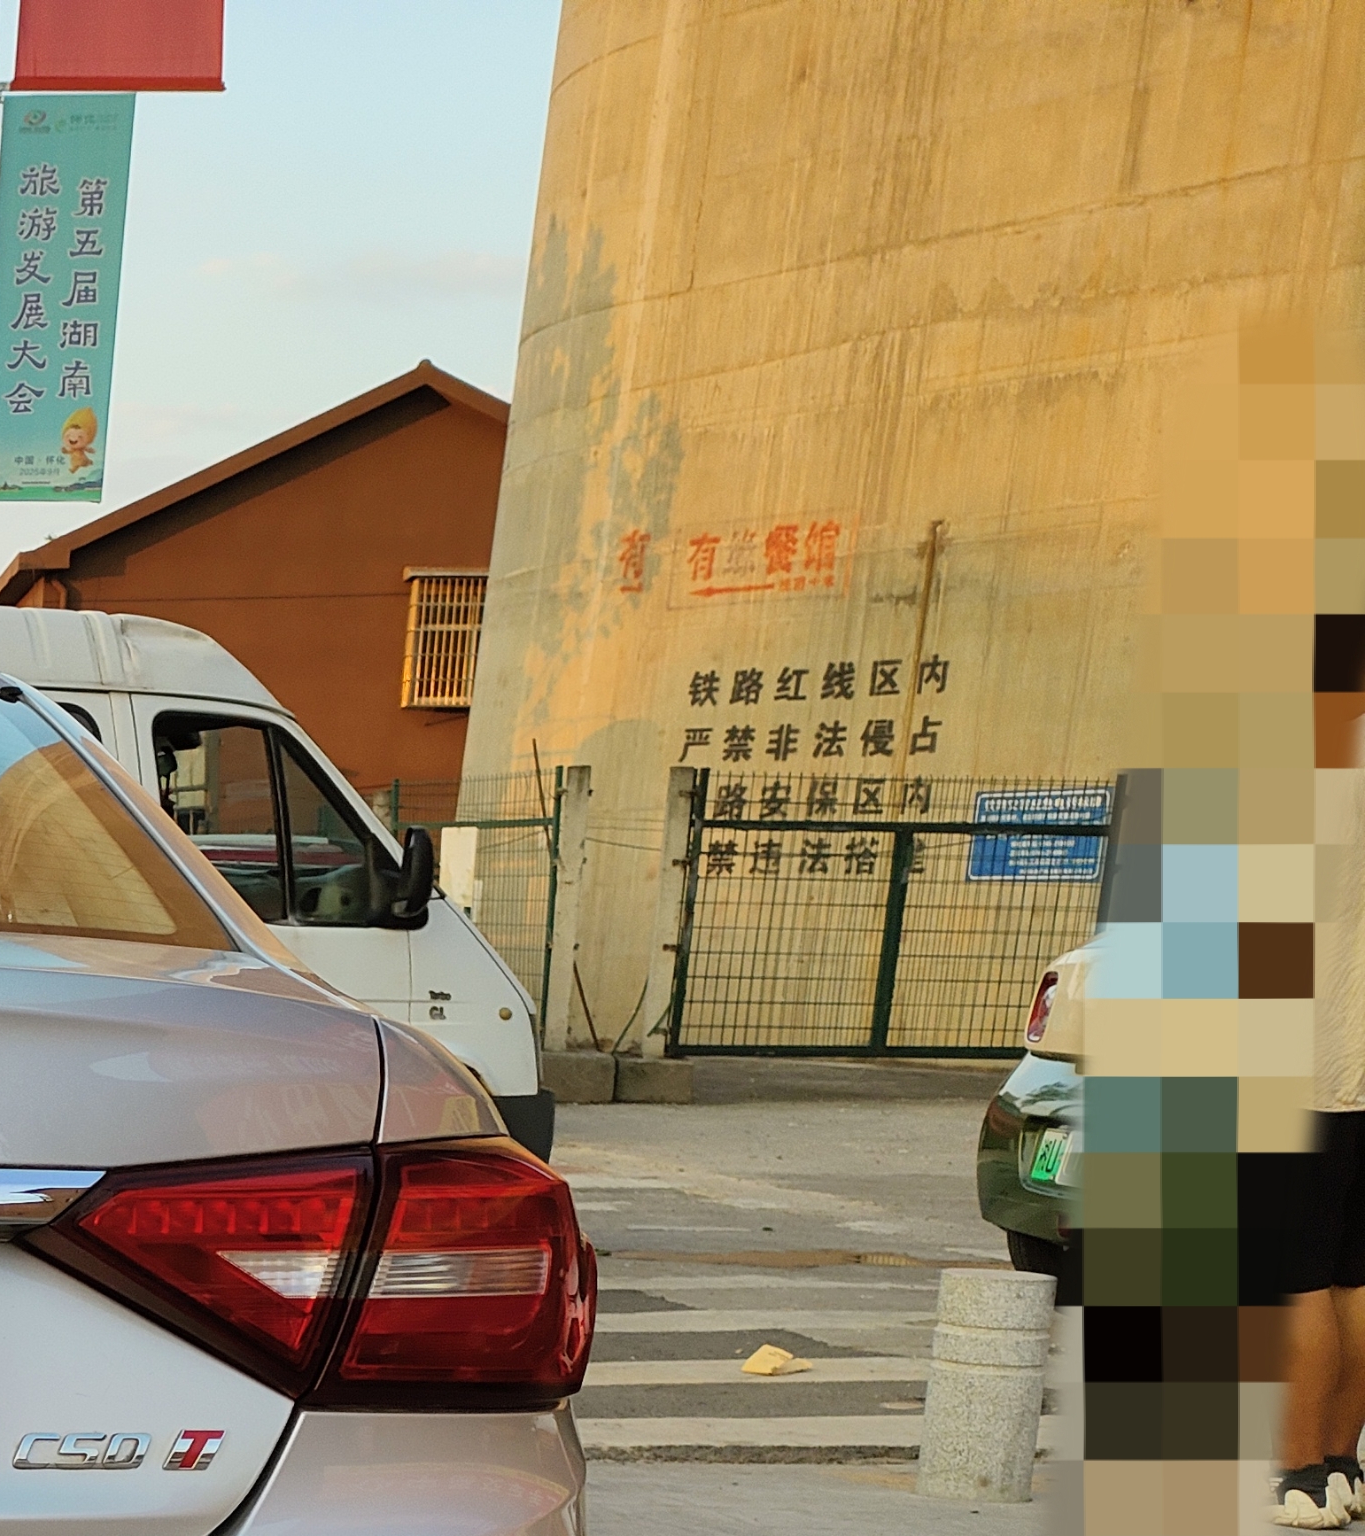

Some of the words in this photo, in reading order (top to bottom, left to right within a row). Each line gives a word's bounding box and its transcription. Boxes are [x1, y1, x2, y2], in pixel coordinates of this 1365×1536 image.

[4, 162, 62, 415] 旅游发展大会
[56, 177, 110, 400] 第五届湖南
[688, 654, 951, 707] 铁路红线区内
[679, 716, 944, 763] 严禁非法侵占
[12, 1432, 151, 1470] C50
[167, 1430, 226, 1470] T
